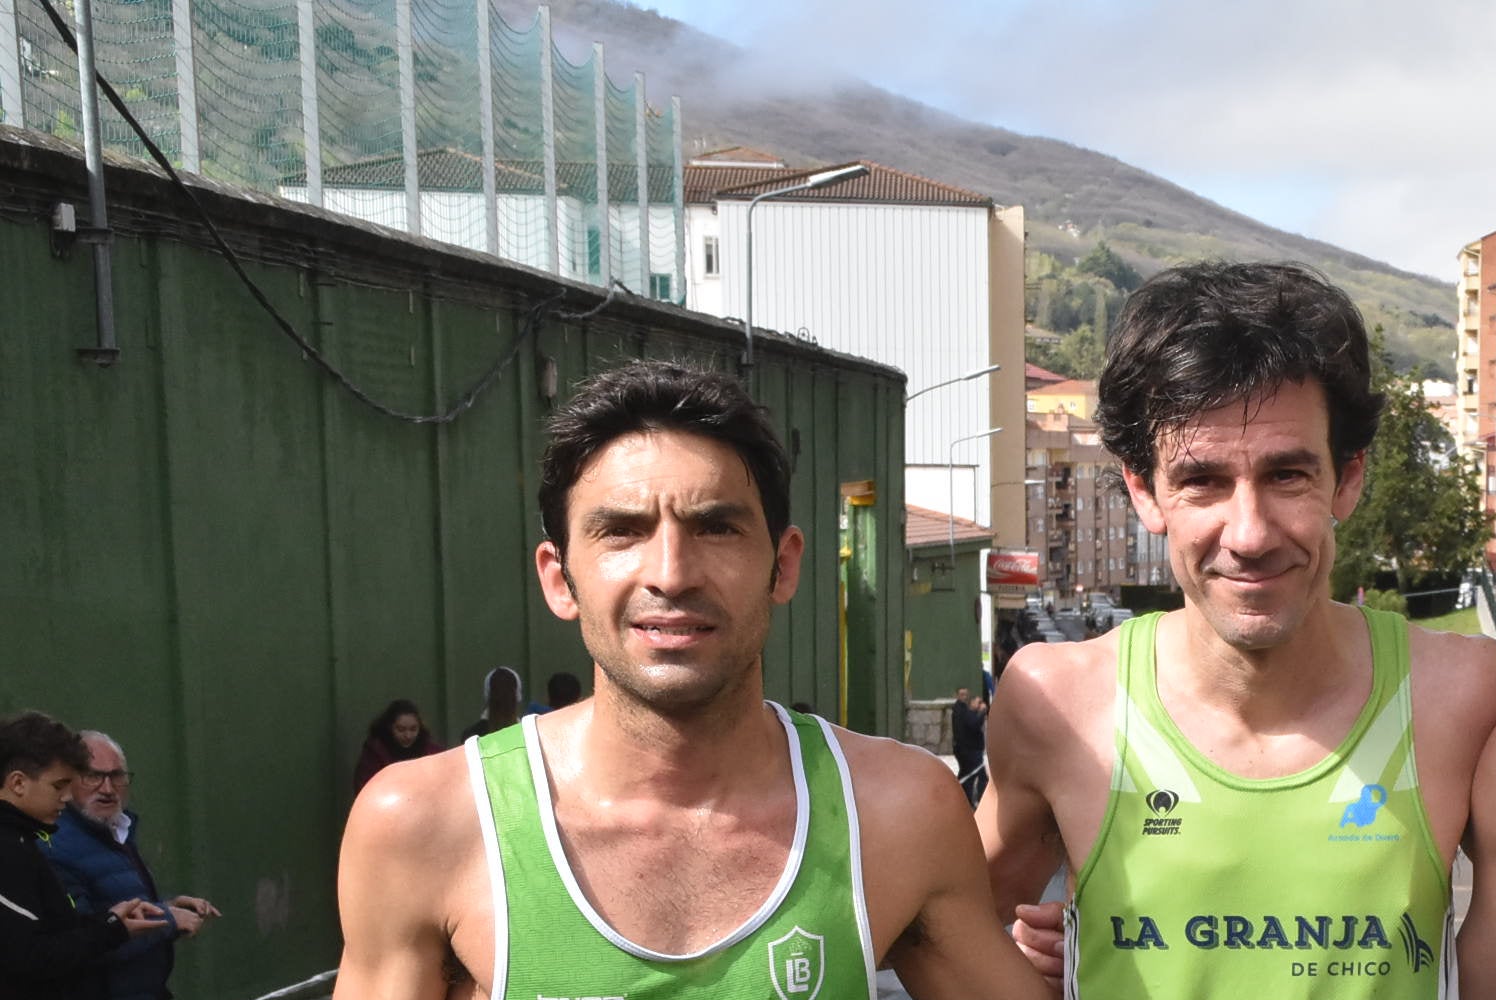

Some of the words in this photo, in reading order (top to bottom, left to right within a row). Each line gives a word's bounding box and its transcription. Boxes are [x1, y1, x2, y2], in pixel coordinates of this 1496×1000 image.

[1143, 818, 1182, 827] SPORTING
[1110, 915, 1170, 951] LA
[1184, 914, 1393, 951] GRANJA
[1291, 962, 1318, 977] DE
[1327, 961, 1391, 977] CHICO
